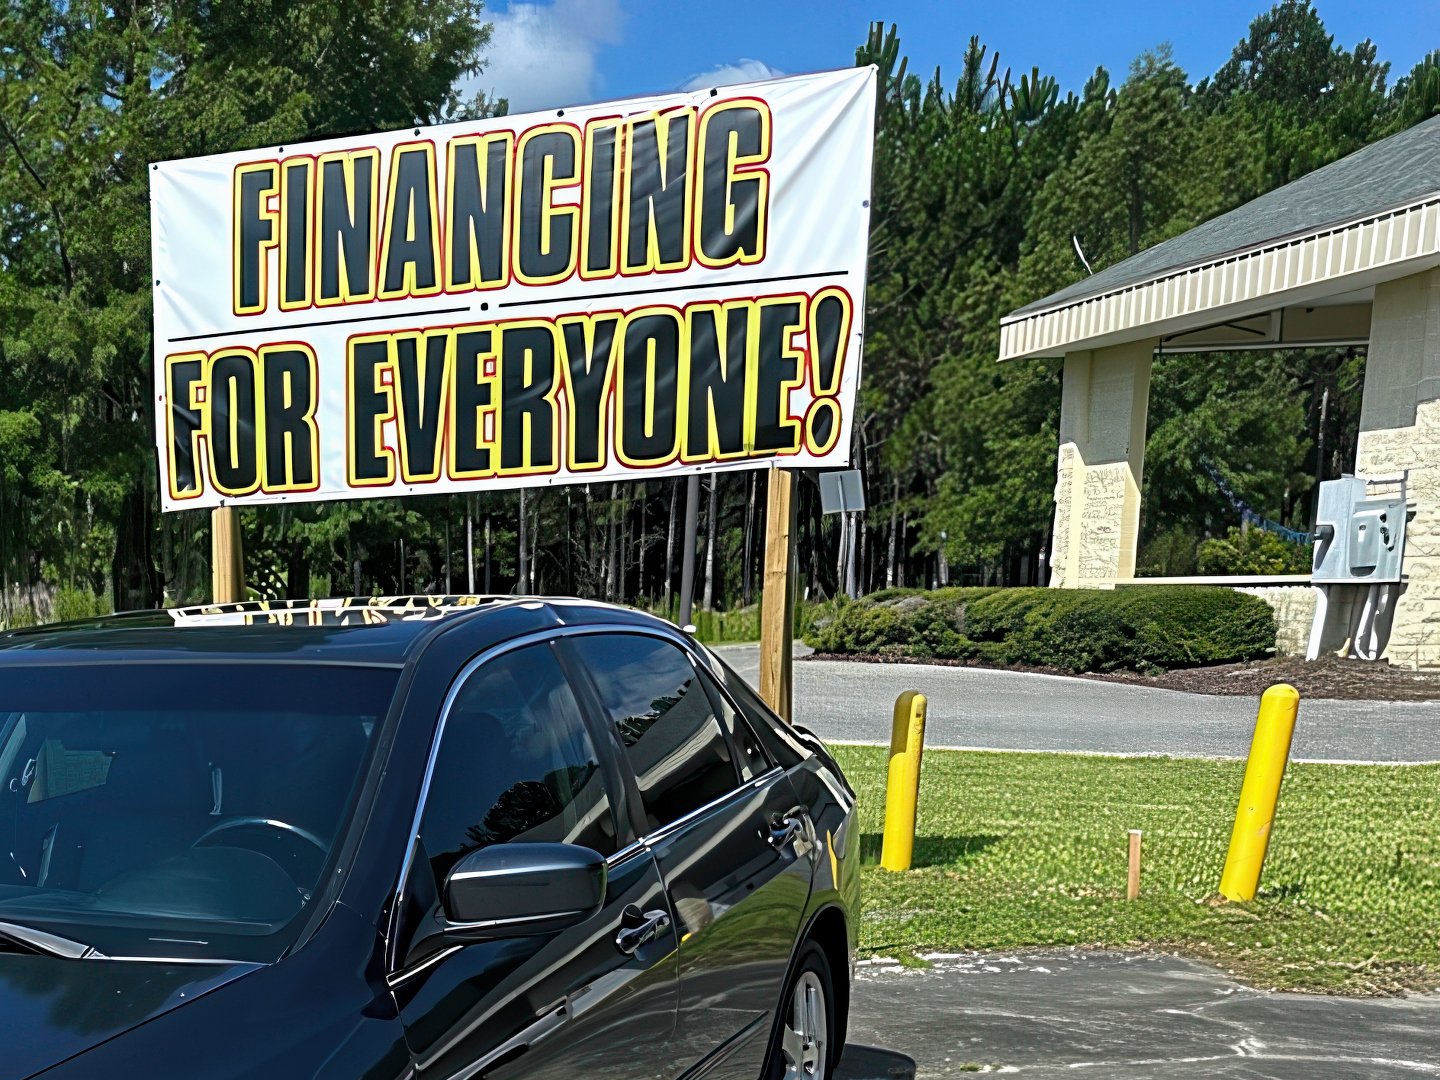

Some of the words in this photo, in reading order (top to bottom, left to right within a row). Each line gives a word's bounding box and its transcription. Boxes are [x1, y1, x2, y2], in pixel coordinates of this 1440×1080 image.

[232, 95, 773, 318] FINANCING
[164, 341, 320, 500] FOR
[346, 286, 854, 488] EVERYONE!
